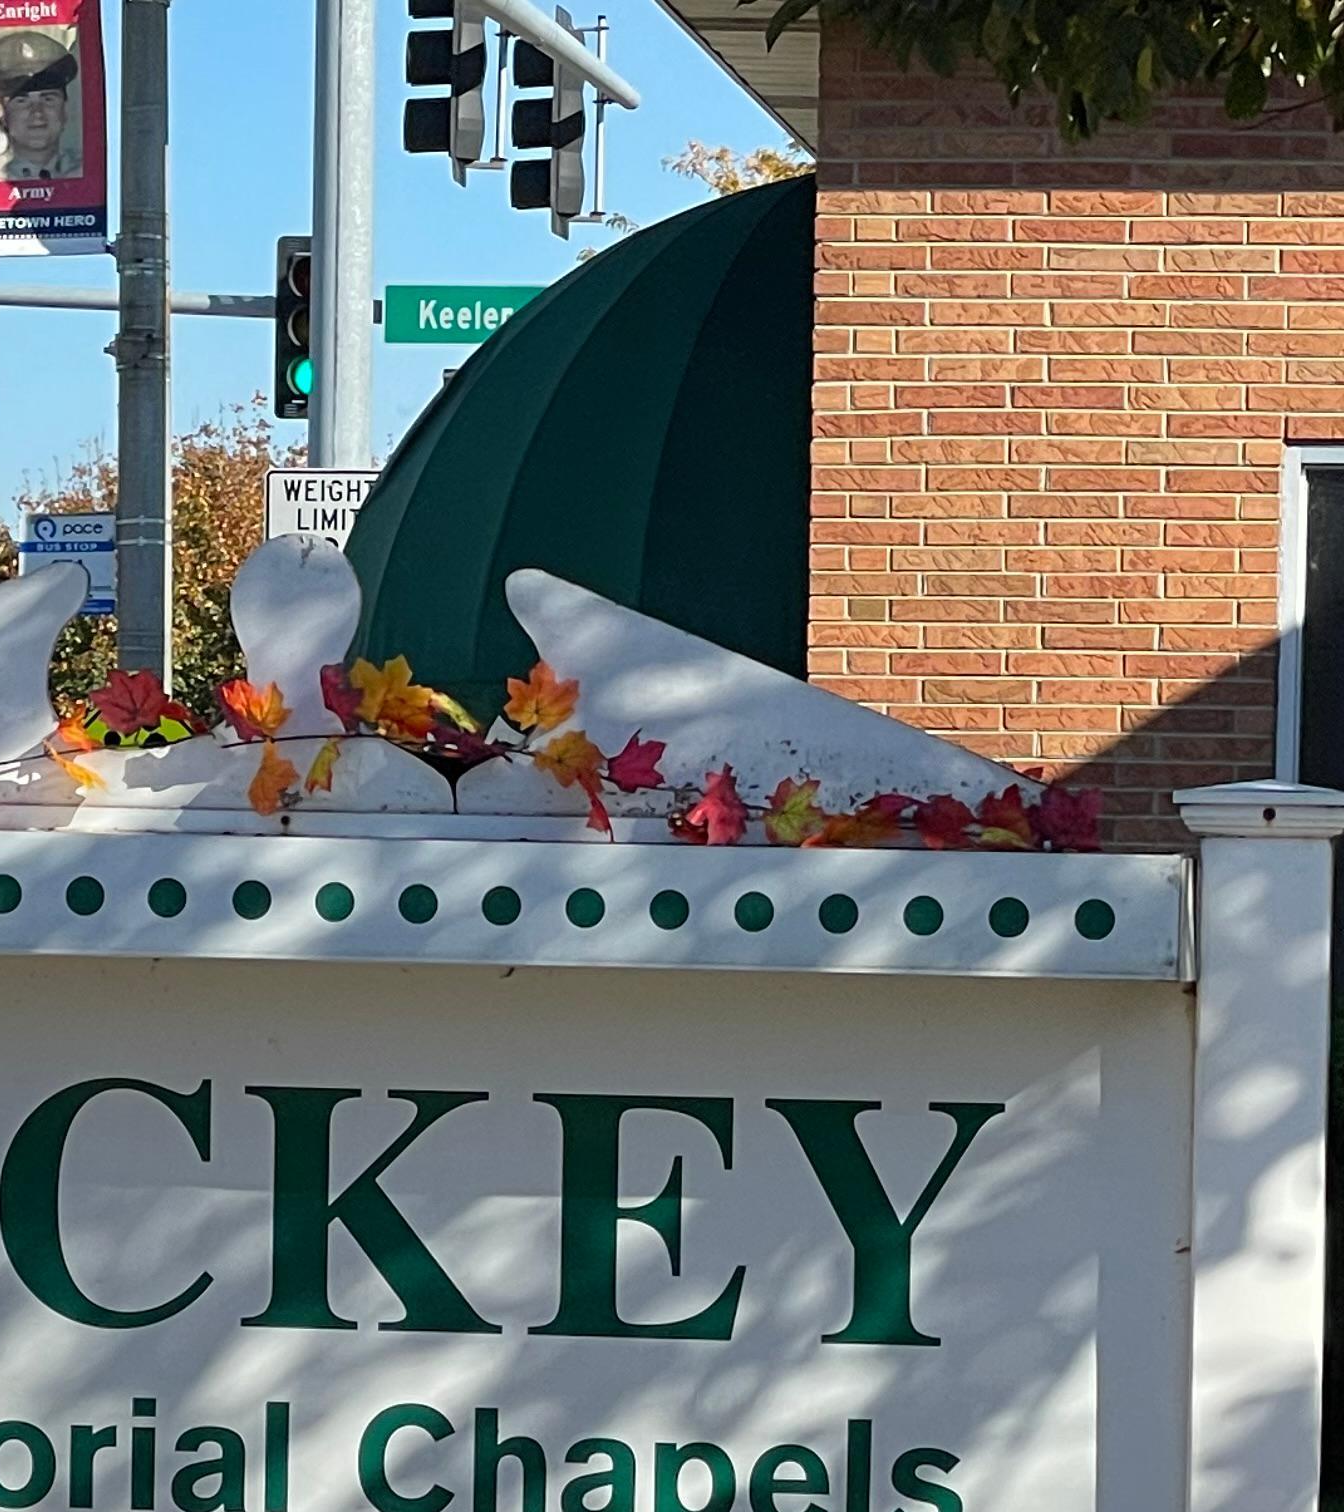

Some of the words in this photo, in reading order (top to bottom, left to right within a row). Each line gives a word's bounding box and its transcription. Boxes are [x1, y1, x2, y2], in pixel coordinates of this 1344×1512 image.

[8, 186, 55, 201] Army
[54, 214, 96, 227] HERO
[419, 299, 514, 330] Keeler
[62, 523, 103, 536] pace
[36, 542, 61, 552] BUS
[65, 542, 98, 552] STOP
